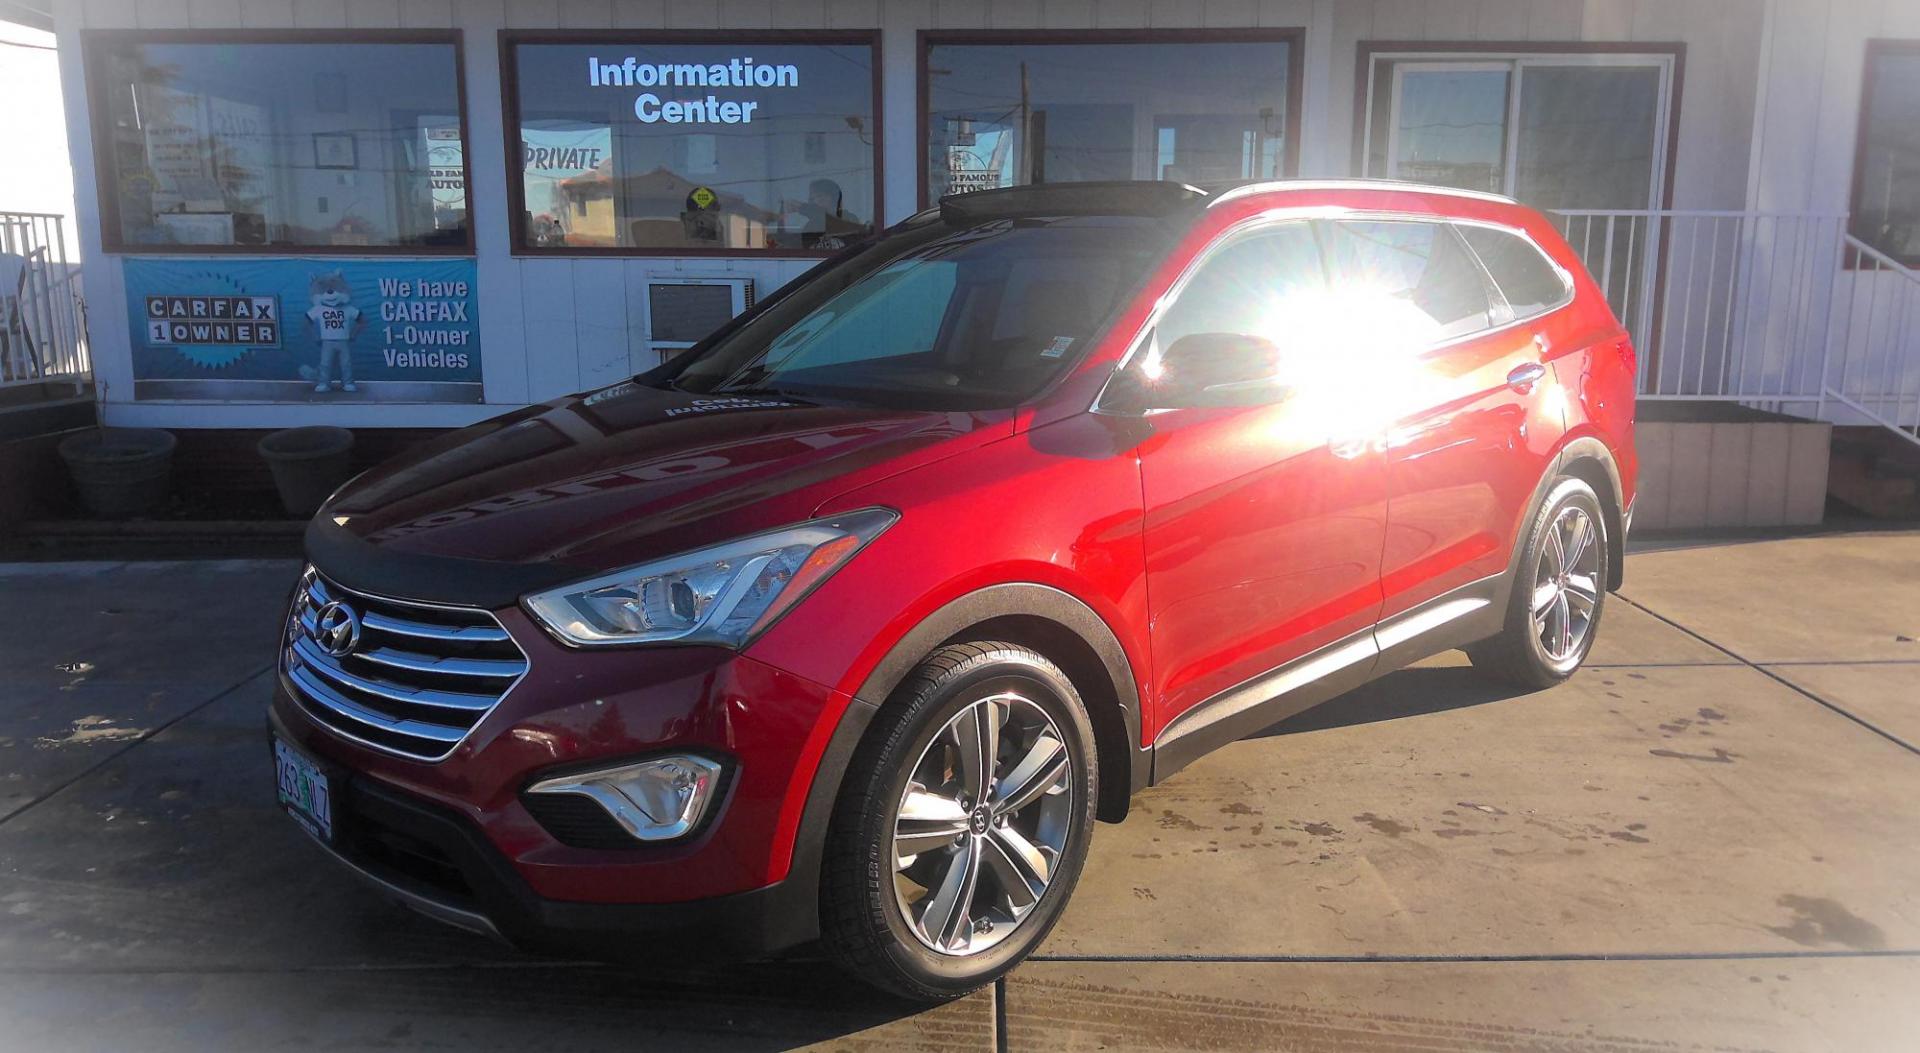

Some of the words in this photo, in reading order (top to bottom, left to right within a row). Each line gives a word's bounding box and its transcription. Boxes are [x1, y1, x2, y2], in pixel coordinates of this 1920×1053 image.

[588, 56, 798, 87] Information
[634, 93, 757, 123] Center
[525, 147, 600, 170] PRIVATE
[379, 278, 410, 297] We
[417, 277, 467, 297] have
[150, 299, 271, 320] CARFAX
[322, 310, 345, 320] CAR
[381, 302, 467, 322] CARFAX
[325, 320, 345, 330] FOX
[383, 326, 470, 346] 1-Owner
[383, 348, 469, 369] Vehicles
